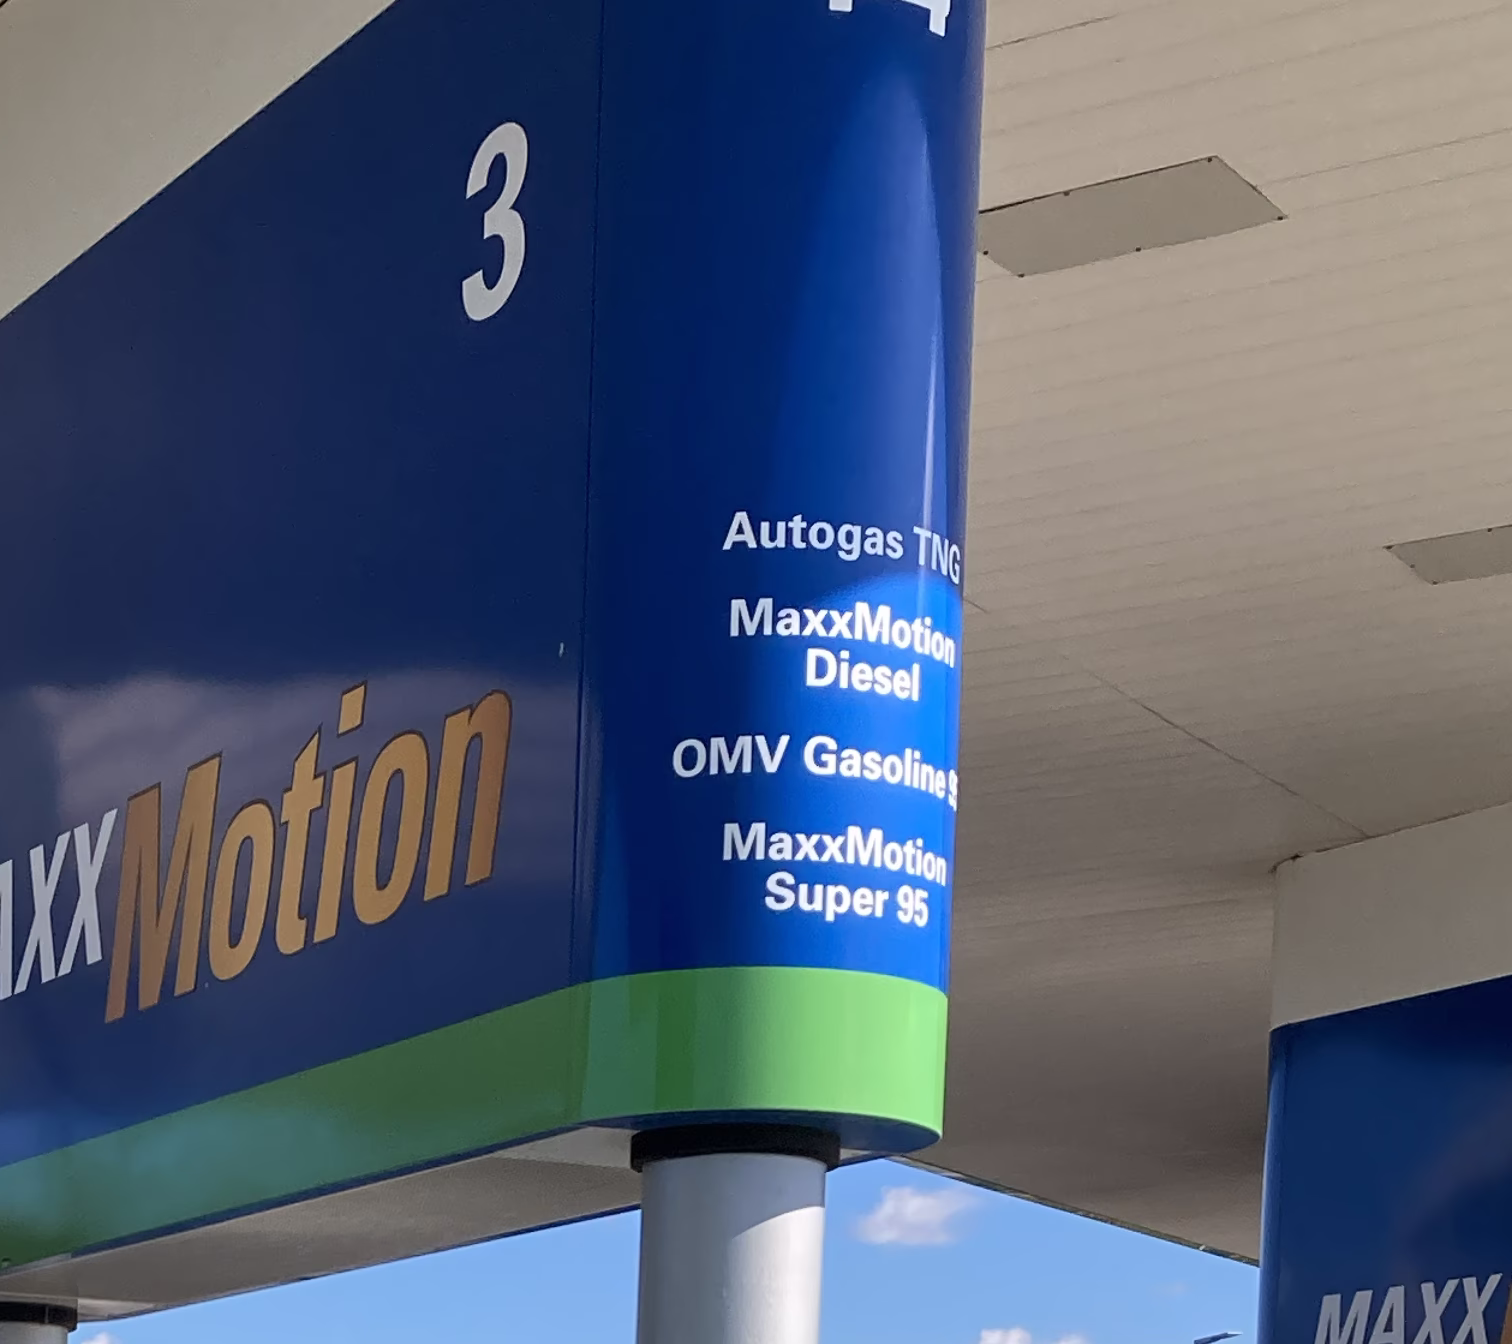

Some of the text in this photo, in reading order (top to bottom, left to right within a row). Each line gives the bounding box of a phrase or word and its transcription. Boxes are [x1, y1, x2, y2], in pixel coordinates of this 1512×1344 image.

[461, 121, 529, 322] 3
[722, 511, 962, 585] Autogas TNG
[729, 597, 956, 668] MaxxMotion
[805, 647, 921, 701] Diesel
[672, 735, 790, 778] OMV
[803, 735, 947, 801] Gasoline
[722, 821, 948, 887] MaxxMotion
[764, 871, 929, 928] Super 95
